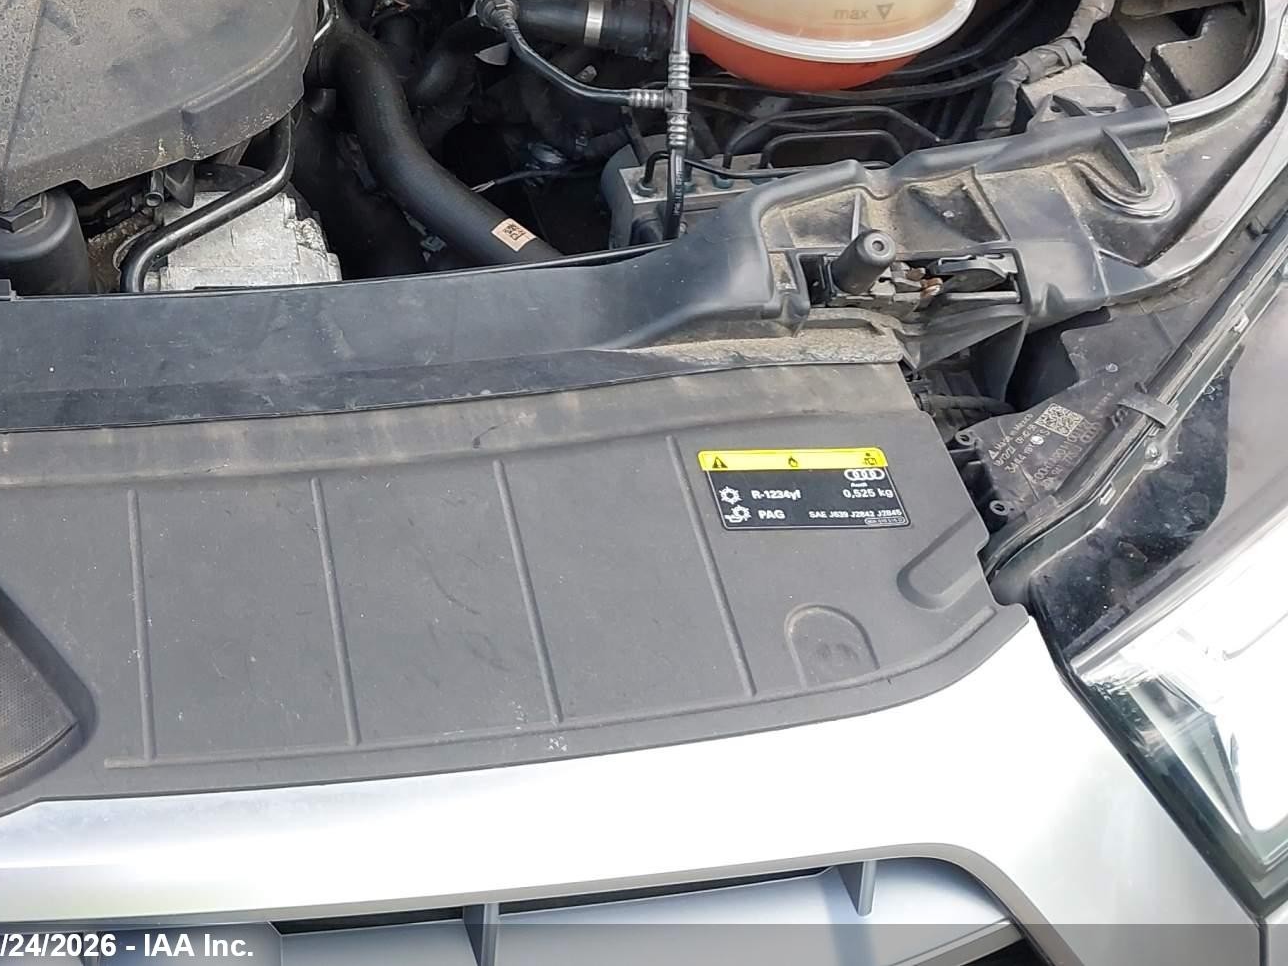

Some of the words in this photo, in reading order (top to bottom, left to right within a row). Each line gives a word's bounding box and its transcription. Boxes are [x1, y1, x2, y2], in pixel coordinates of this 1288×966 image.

[834, 9, 869, 20] max
[877, 488, 893, 498] kg
[758, 510, 786, 519] PAG
